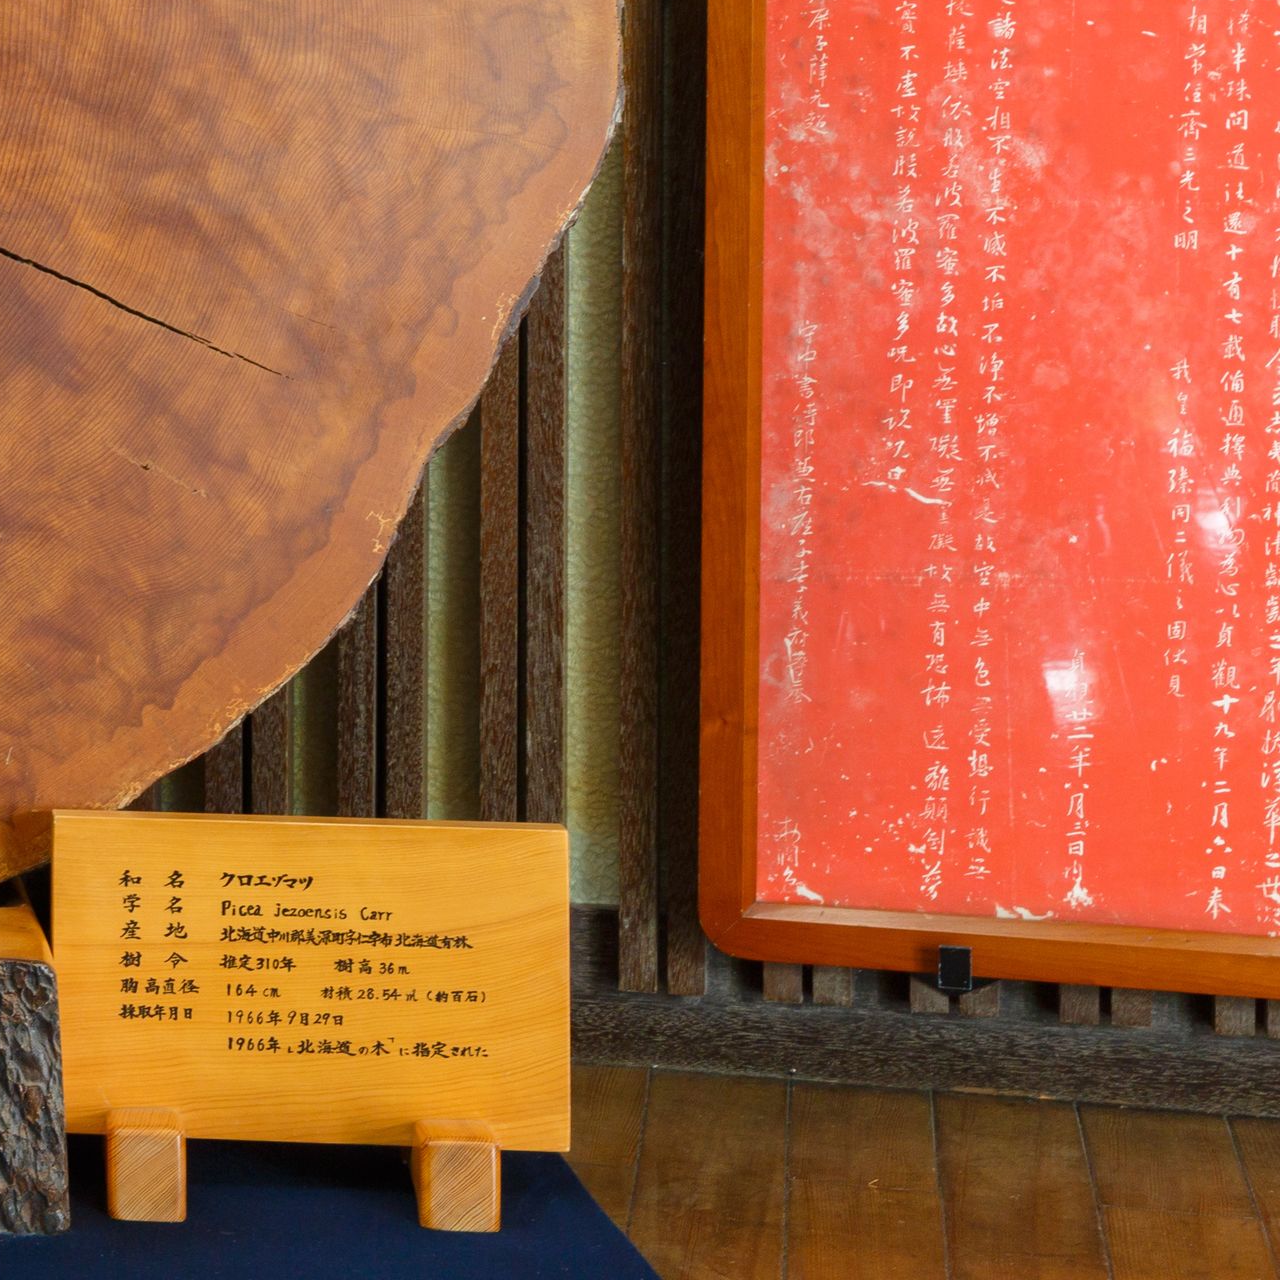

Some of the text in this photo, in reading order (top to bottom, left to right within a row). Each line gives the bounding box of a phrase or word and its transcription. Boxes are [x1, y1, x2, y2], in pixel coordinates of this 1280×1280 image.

[219, 871, 314, 891] クロエゾマツ
[221, 900, 264, 917] Picea
[273, 902, 347, 920] jezoensis
[360, 906, 393, 922] Carr
[219, 954, 297, 972] 推定310年
[119, 1004, 193, 1021] 採取年月日
